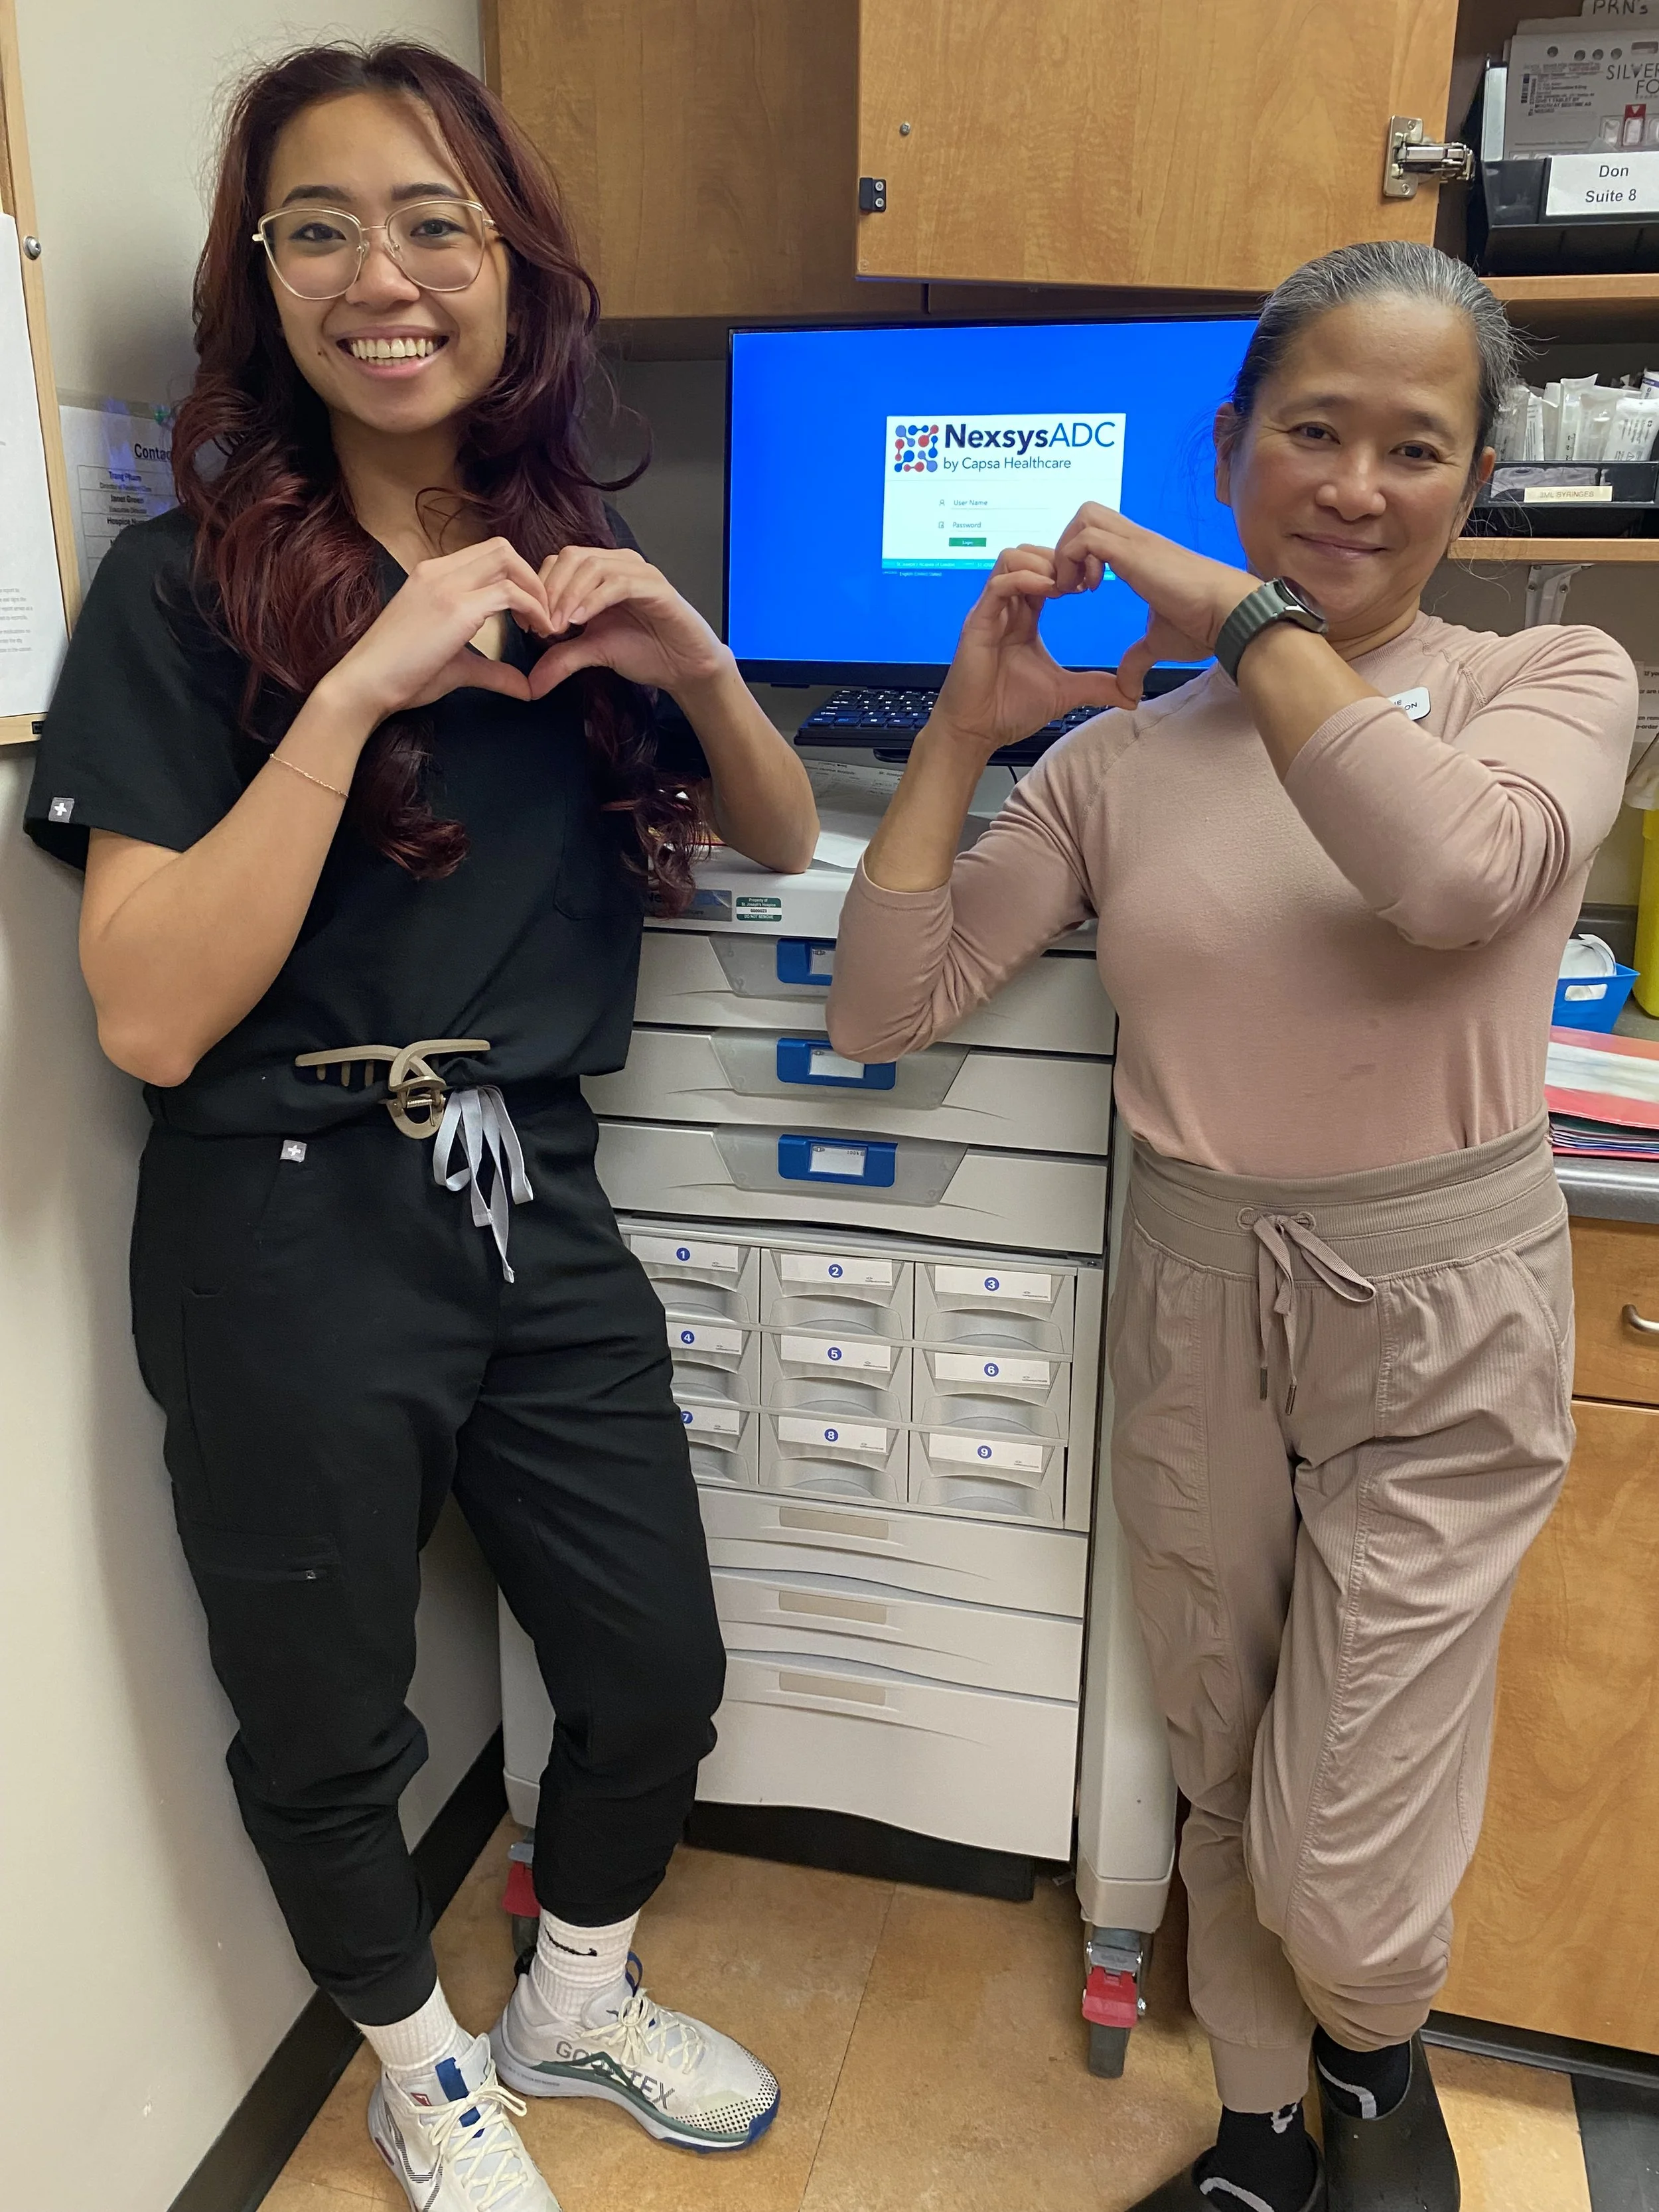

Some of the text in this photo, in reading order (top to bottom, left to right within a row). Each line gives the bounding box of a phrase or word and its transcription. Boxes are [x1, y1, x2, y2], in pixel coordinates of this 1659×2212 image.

[1599, 165, 1629, 177] Don
[1585, 188, 1636, 203] Suite 8
[944, 421, 1116, 455] NexsysADC
[944, 456, 1072, 472] by Capsa Healthcare
[832, 1267, 839, 1276] 2
[988, 1280, 995, 1289] 3
[831, 1350, 837, 1359] 5
[987, 1366, 995, 1374] 6
[828, 1432, 835, 1440] 8
[981, 1448, 988, 1457] 9
